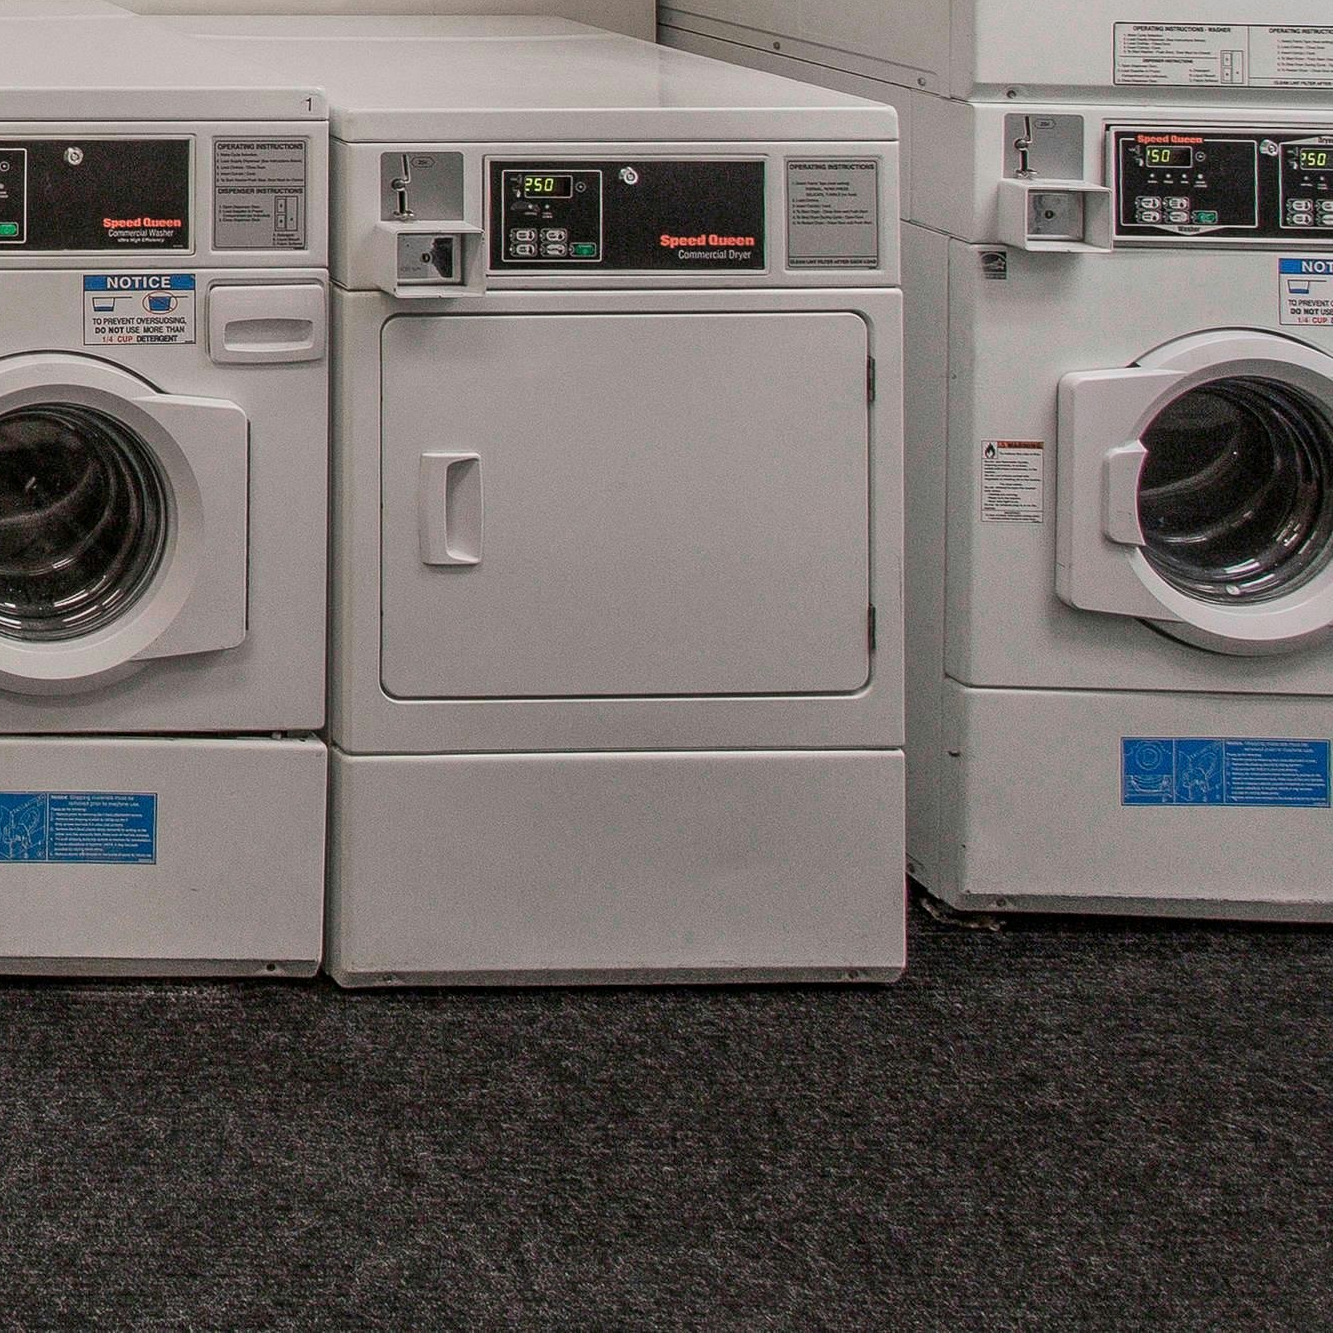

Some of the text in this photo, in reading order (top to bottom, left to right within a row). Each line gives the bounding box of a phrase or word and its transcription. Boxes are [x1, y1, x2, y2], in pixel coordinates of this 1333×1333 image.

[305, 97, 312, 112] 1
[1137, 135, 1204, 144] Speed Queen
[1147, 149, 1171, 163] 50
[103, 217, 182, 229] Speed Queen
[108, 229, 174, 237] Commercial Washer
[660, 234, 755, 248] Speed Queen
[678, 249, 752, 261] Commercial Dryer
[1301, 260, 1333, 273] NOT
[106, 276, 171, 289] NOTICE
[1298, 299, 1329, 307] PREVENT
[93, 317, 102, 326] TO
[103, 317, 135, 326] PREVENT
[108, 326, 124, 334] NOT
[125, 326, 140, 334] USE
[142, 326, 164, 334] MORE
[117, 335, 133, 343] CUP
[136, 334, 178, 343] DETERGENT
